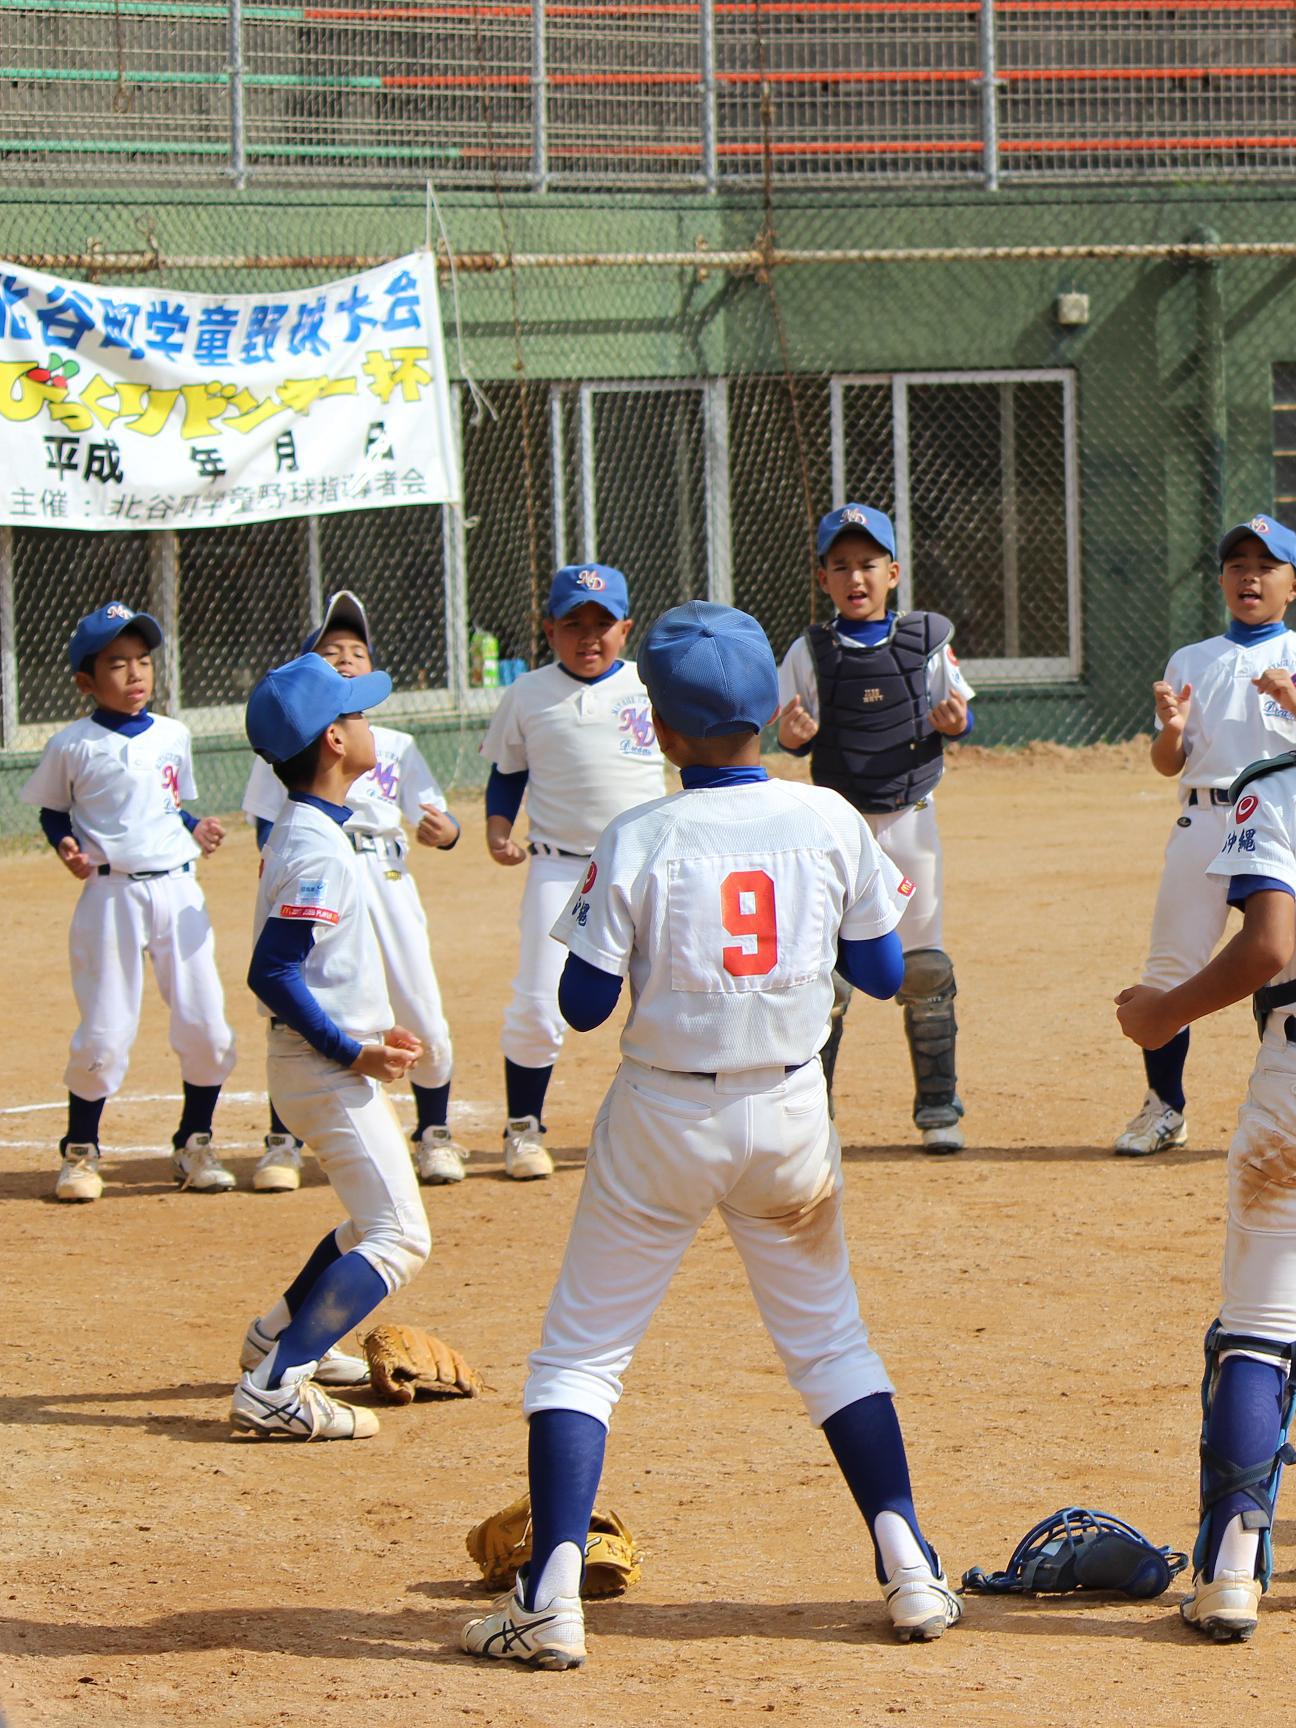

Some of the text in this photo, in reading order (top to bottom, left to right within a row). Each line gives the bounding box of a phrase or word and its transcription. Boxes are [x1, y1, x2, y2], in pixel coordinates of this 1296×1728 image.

[43, 435, 125, 484] 平成
[190, 446, 226, 484] 年
[275, 430, 299, 473] 月
[576, 570, 606, 592] MD
[720, 869, 778, 977] 9
